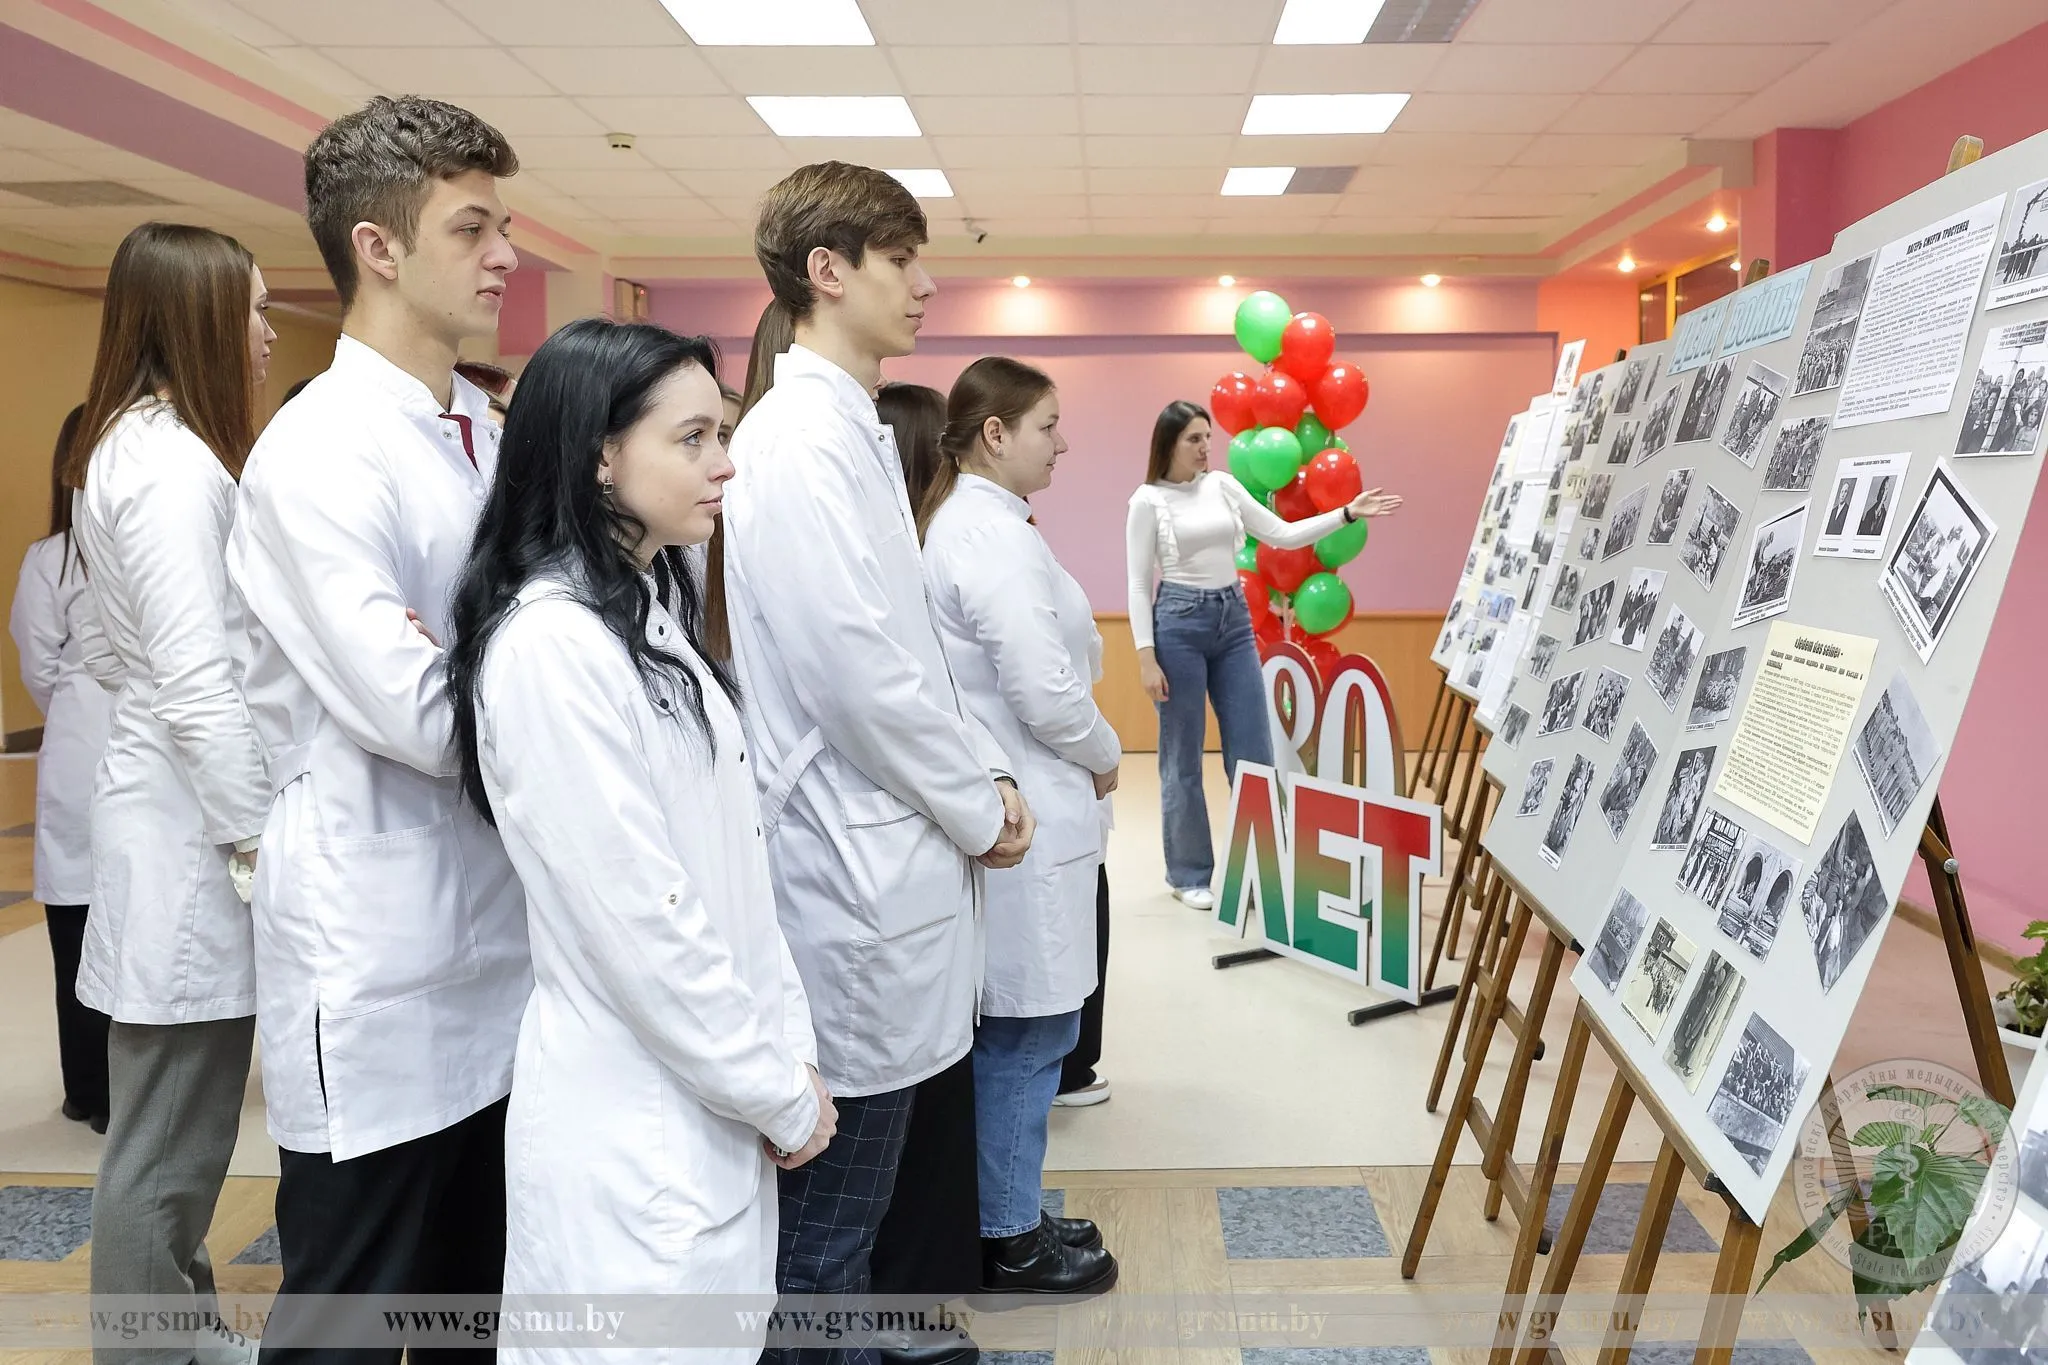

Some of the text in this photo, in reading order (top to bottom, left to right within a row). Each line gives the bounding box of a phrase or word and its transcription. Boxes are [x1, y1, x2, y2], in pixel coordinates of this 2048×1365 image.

[1923, 231, 1941, 248] СМЕРТИ
[1942, 219, 1969, 241] ТРОСТЕНЕЦ
[1723, 278, 1805, 350] ВОЙНЫ
[1813, 641, 1824, 655] das
[1261, 641, 1406, 800] 80
[1214, 768, 1435, 995] ЛЕТ
